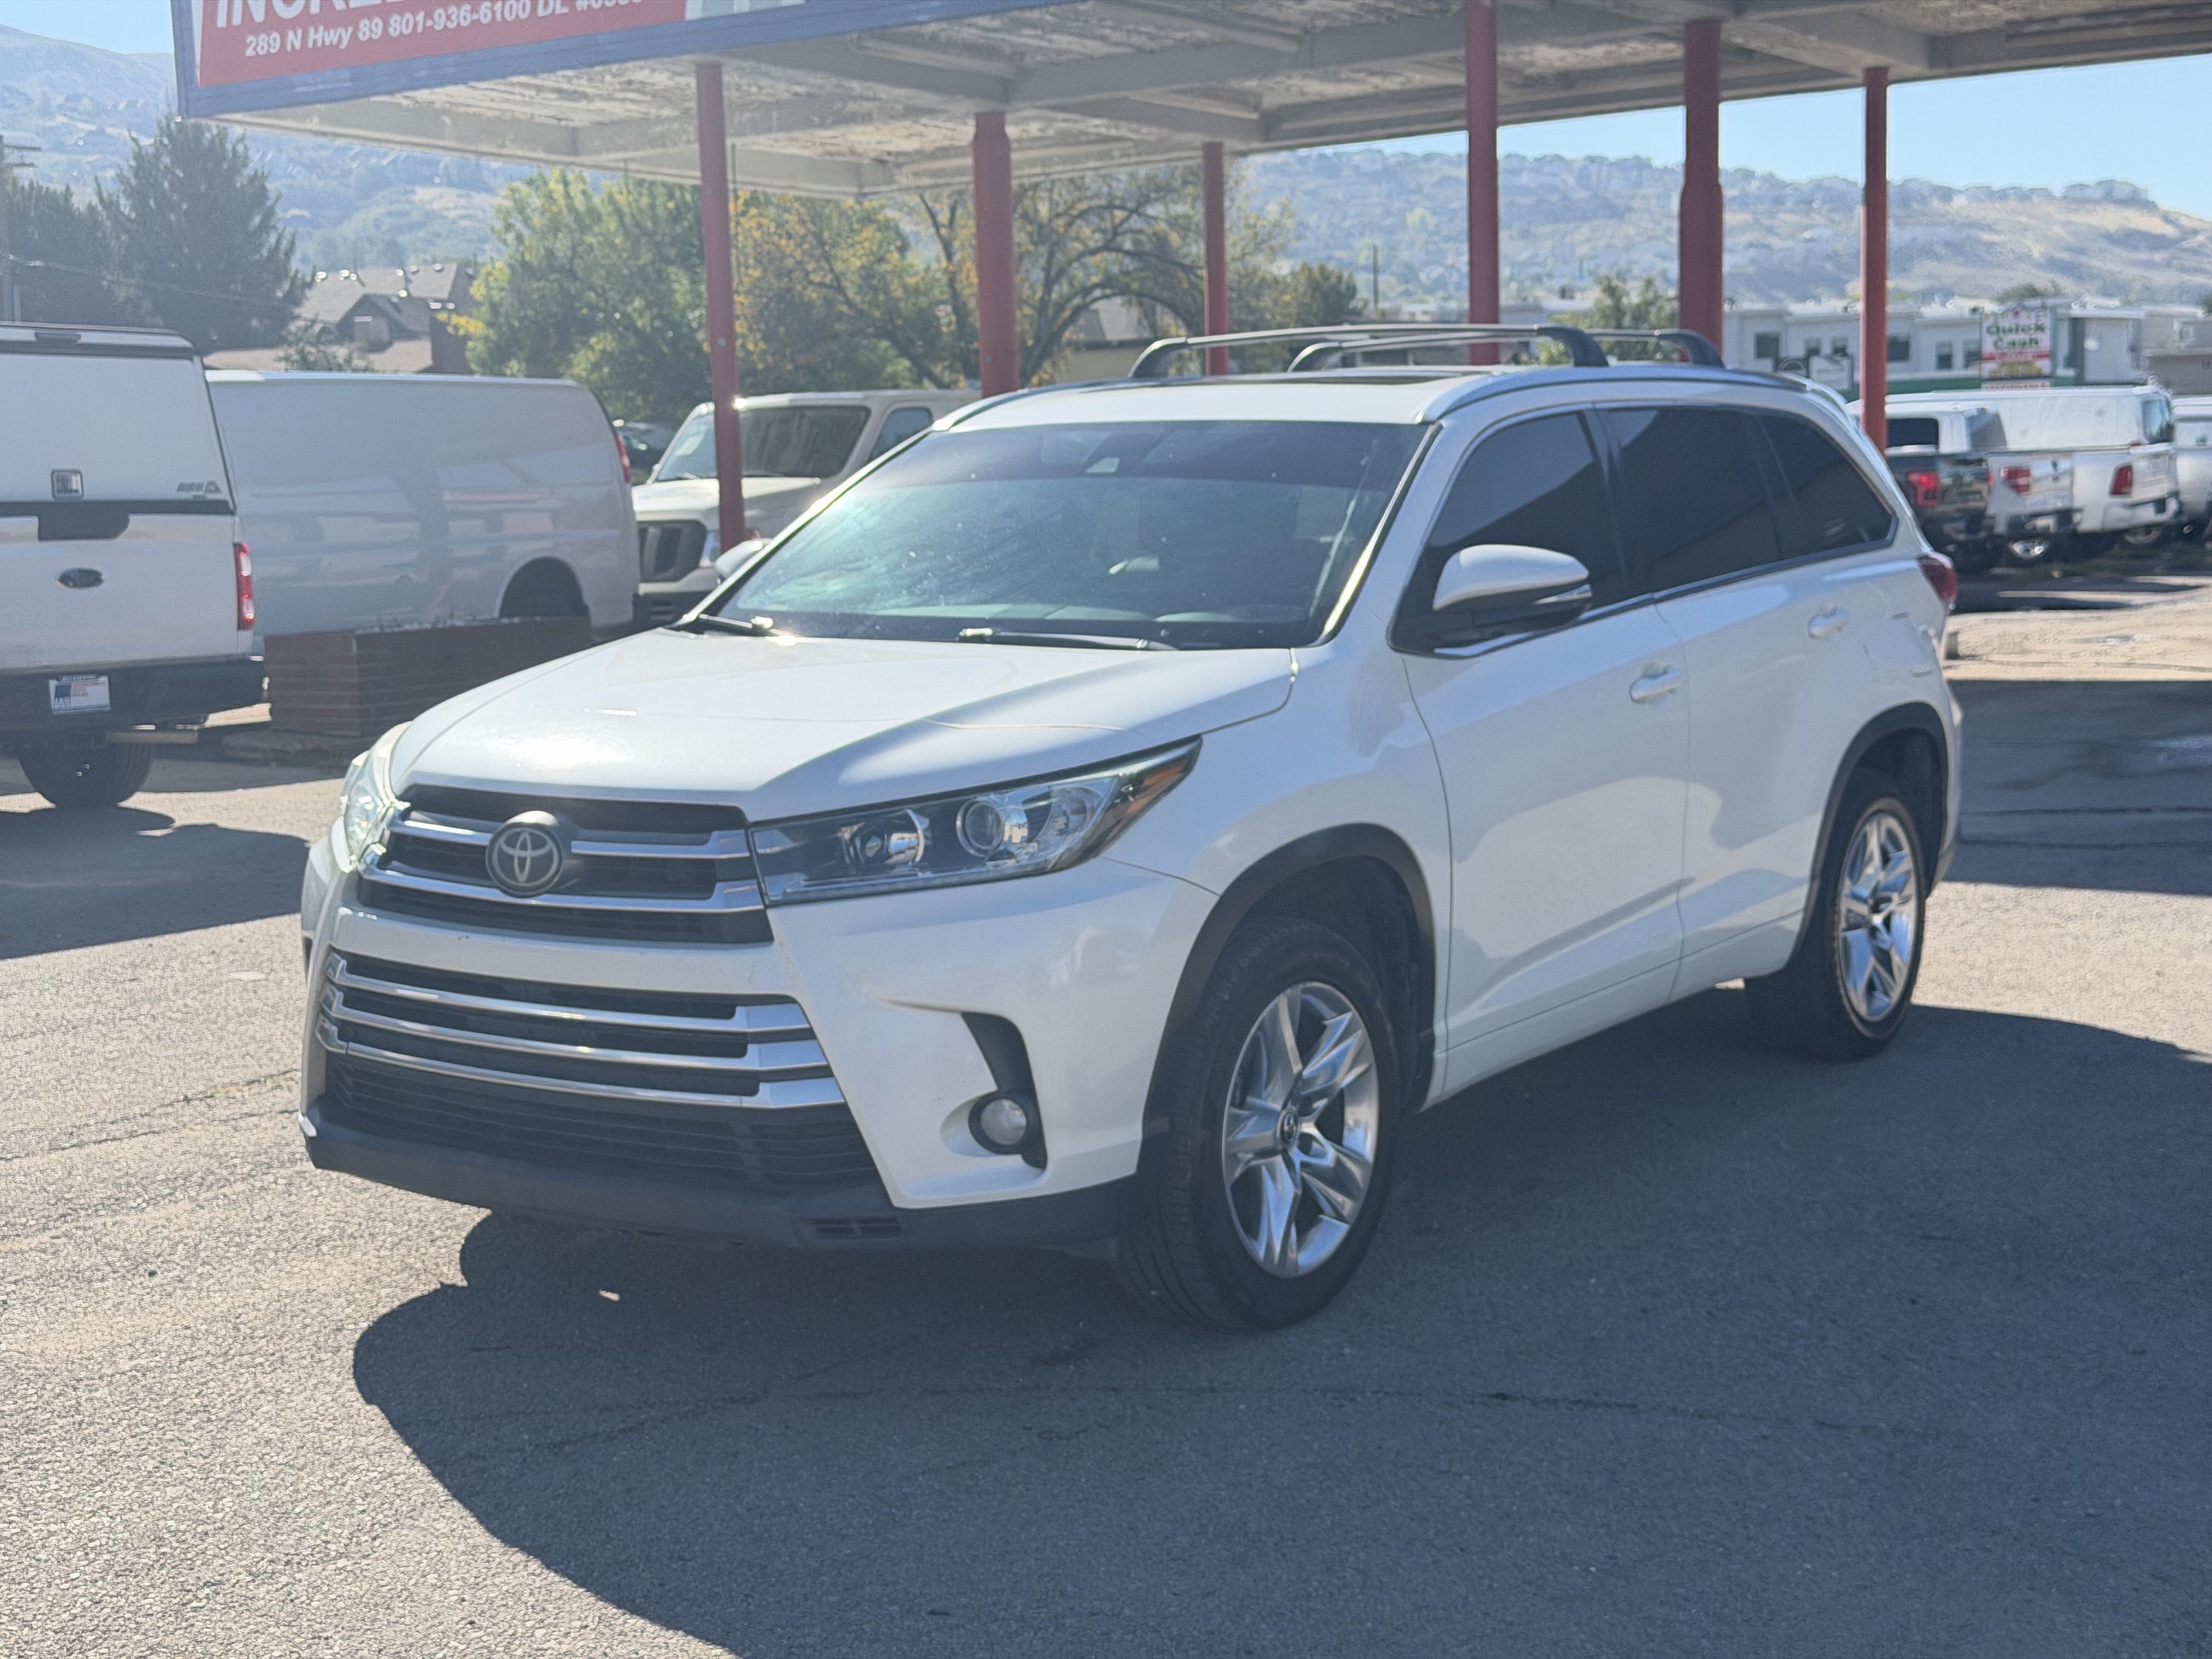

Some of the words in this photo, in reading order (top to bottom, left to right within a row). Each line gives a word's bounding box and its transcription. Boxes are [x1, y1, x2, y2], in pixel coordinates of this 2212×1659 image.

[246, 32, 281, 57] 289
[286, 29, 302, 52] N
[308, 25, 353, 49] Hwy
[358, 17, 383, 42] 89
[388, 0, 531, 37] 801-936-6100
